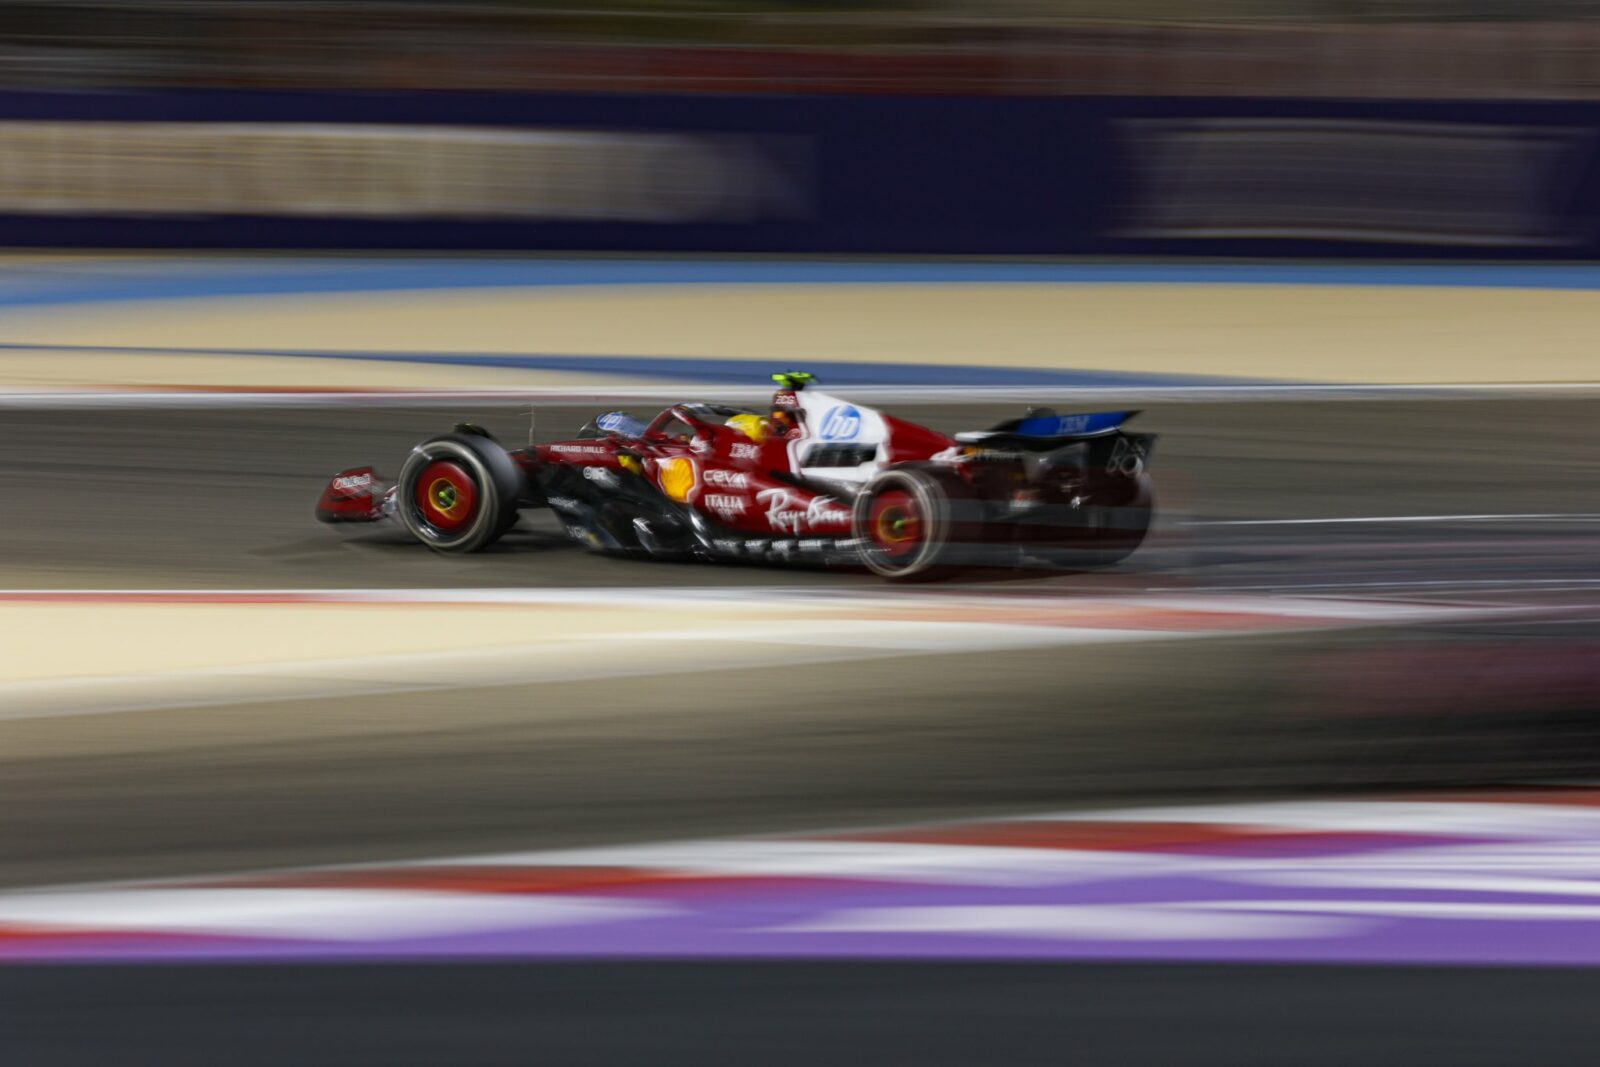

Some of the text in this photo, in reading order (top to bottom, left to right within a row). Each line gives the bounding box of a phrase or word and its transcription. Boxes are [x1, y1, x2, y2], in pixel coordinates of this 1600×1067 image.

[821, 405, 862, 441] hp
[550, 444, 606, 454] RICHARD MILLE
[728, 443, 759, 459] IBM
[704, 494, 744, 510] ITALIA
[756, 488, 845, 533] Ray-Ban
